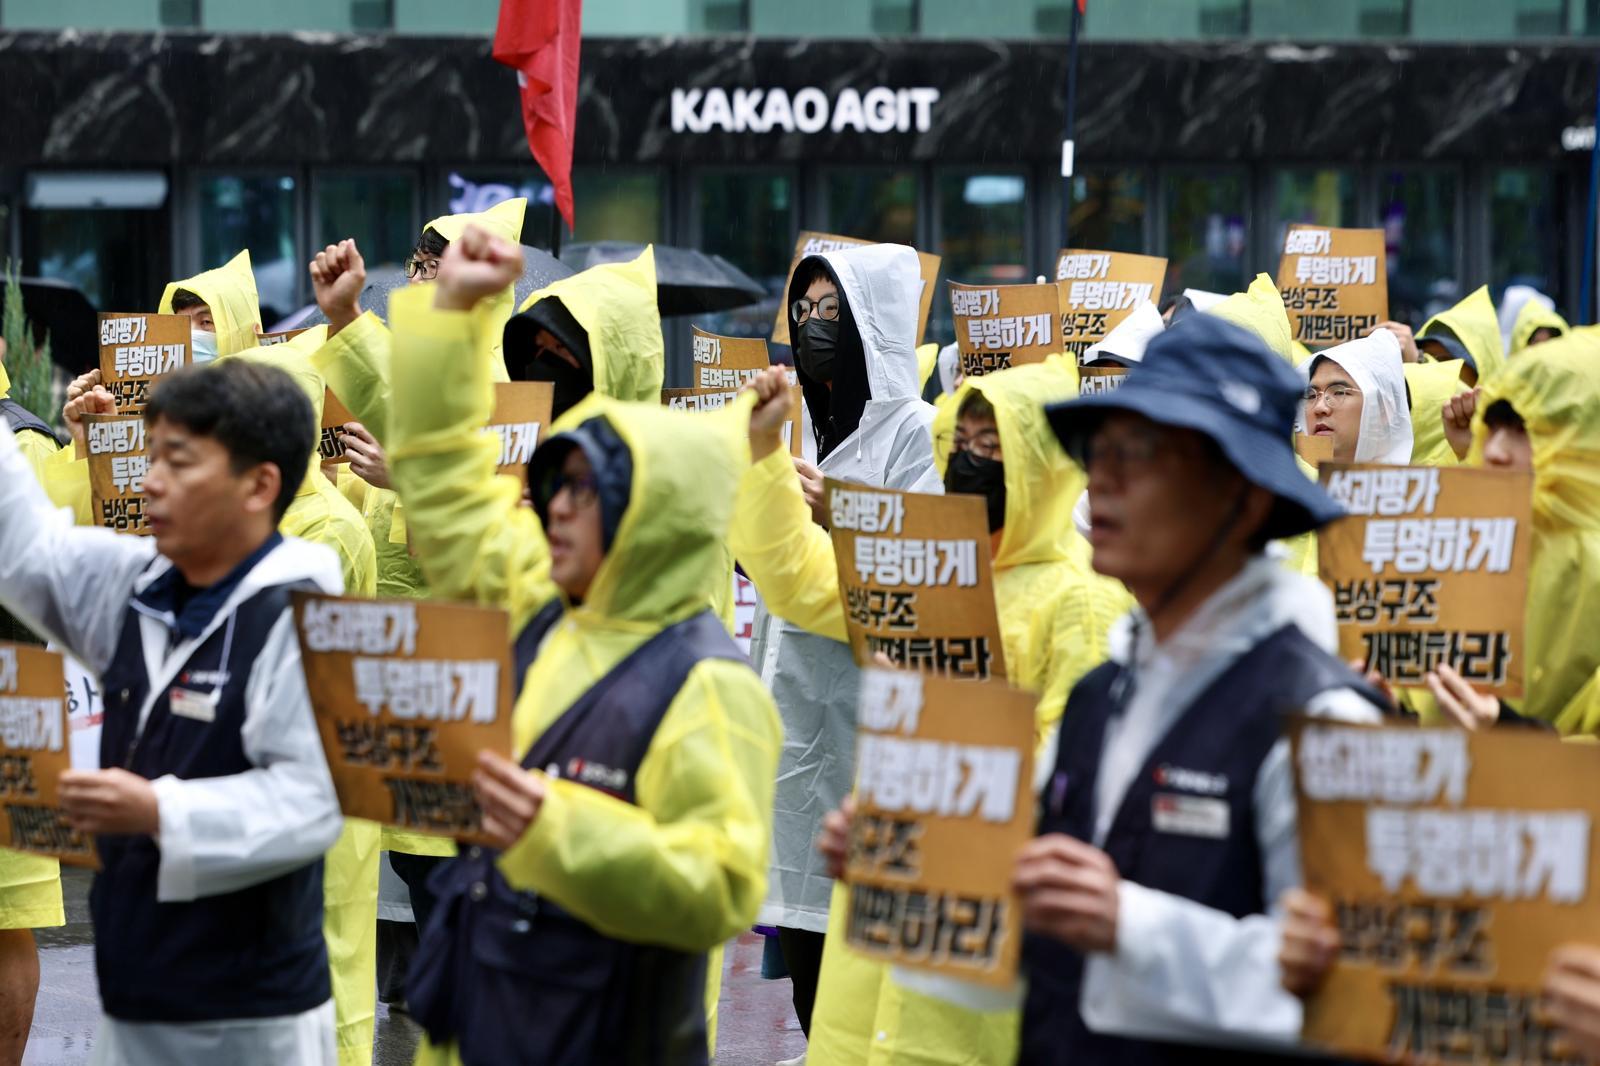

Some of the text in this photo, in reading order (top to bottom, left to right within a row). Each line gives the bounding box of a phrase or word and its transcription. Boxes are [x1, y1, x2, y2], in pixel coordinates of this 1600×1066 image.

[671, 86, 940, 133] KAKAO AGIT
[1285, 230, 1331, 254] 성과평가
[1057, 254, 1111, 280] 성과평가
[1296, 255, 1377, 285] 투명하게
[952, 289, 1000, 316] 성과평가
[1069, 282, 1154, 312] 투명하게
[101, 317, 147, 346] 성과평가
[967, 313, 1052, 350] 투명하게
[1061, 313, 1108, 337] 상구조
[115, 344, 185, 378] 투명하게
[88, 419, 146, 455] 성과평가
[111, 455, 152, 495] 투명
[830, 489, 905, 534] 성과평가
[854, 536, 979, 588] 투명하게
[1362, 518, 1517, 574] 투명하게
[1333, 578, 1441, 623] 보상구조
[303, 600, 419, 655] 성과평가
[1361, 630, 1513, 686] 개편하라
[353, 656, 500, 724] 투명하게
[1365, 807, 1591, 903] 투명하게
